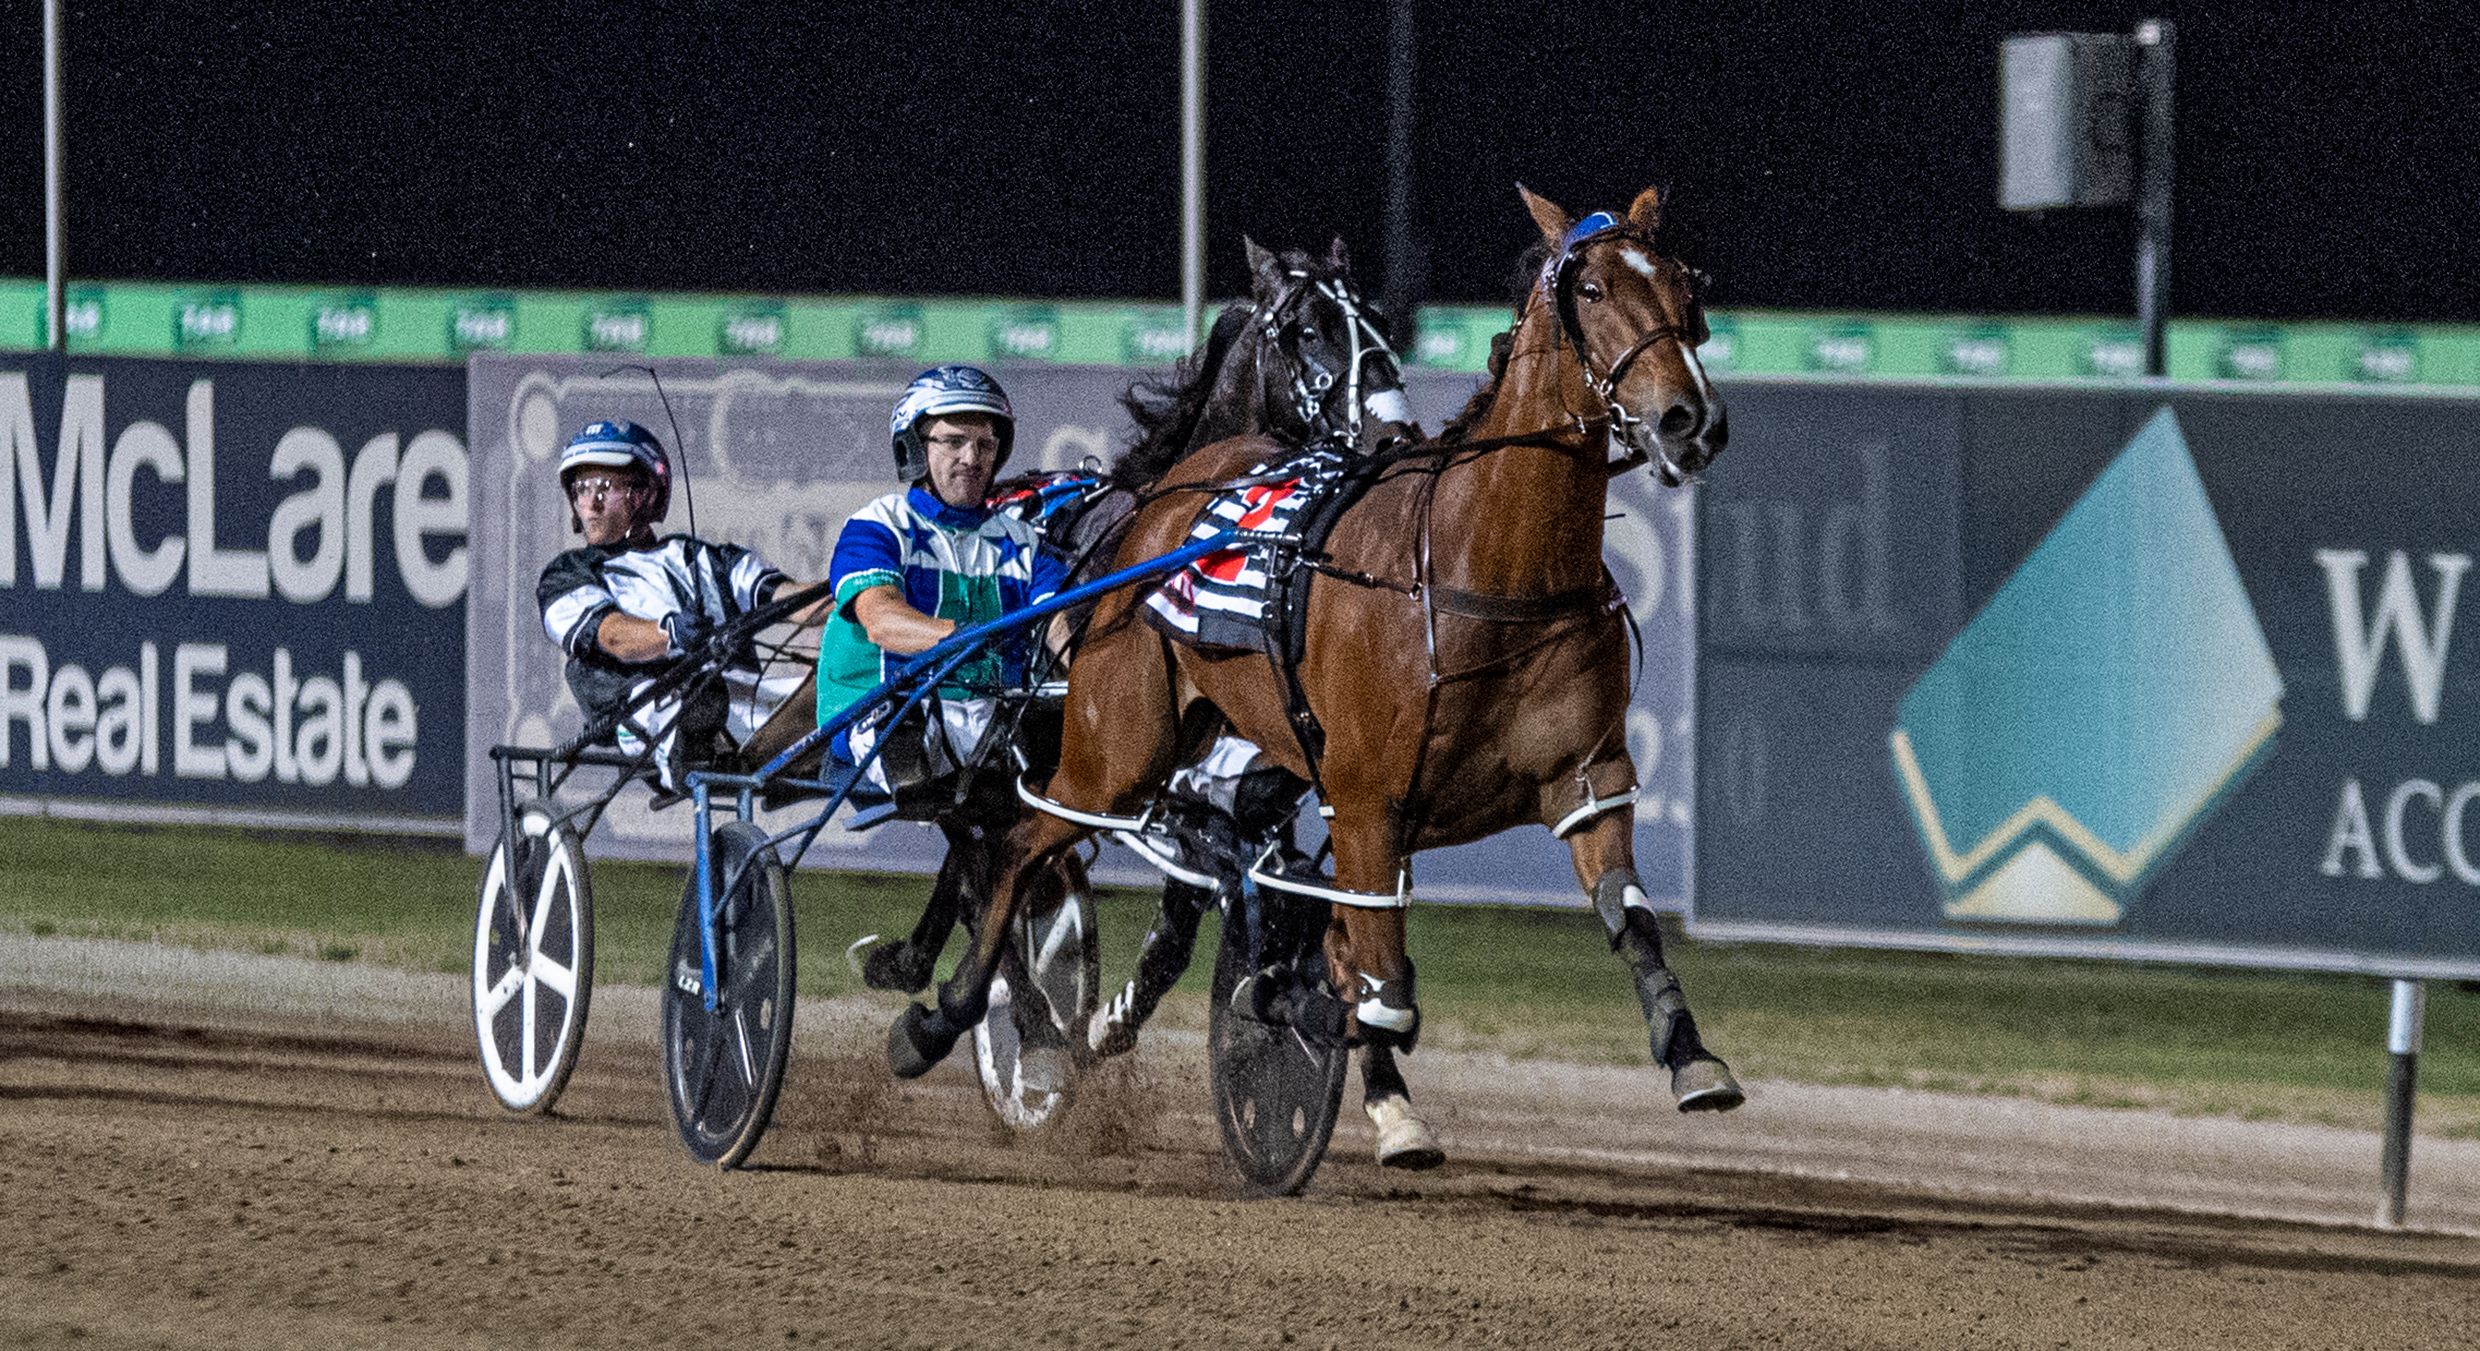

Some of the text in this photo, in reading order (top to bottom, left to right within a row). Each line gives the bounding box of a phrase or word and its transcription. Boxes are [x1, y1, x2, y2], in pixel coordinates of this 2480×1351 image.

[0, 371, 468, 609] McLare
[0, 634, 417, 790] Real Estate
[2313, 548, 2472, 725] W
